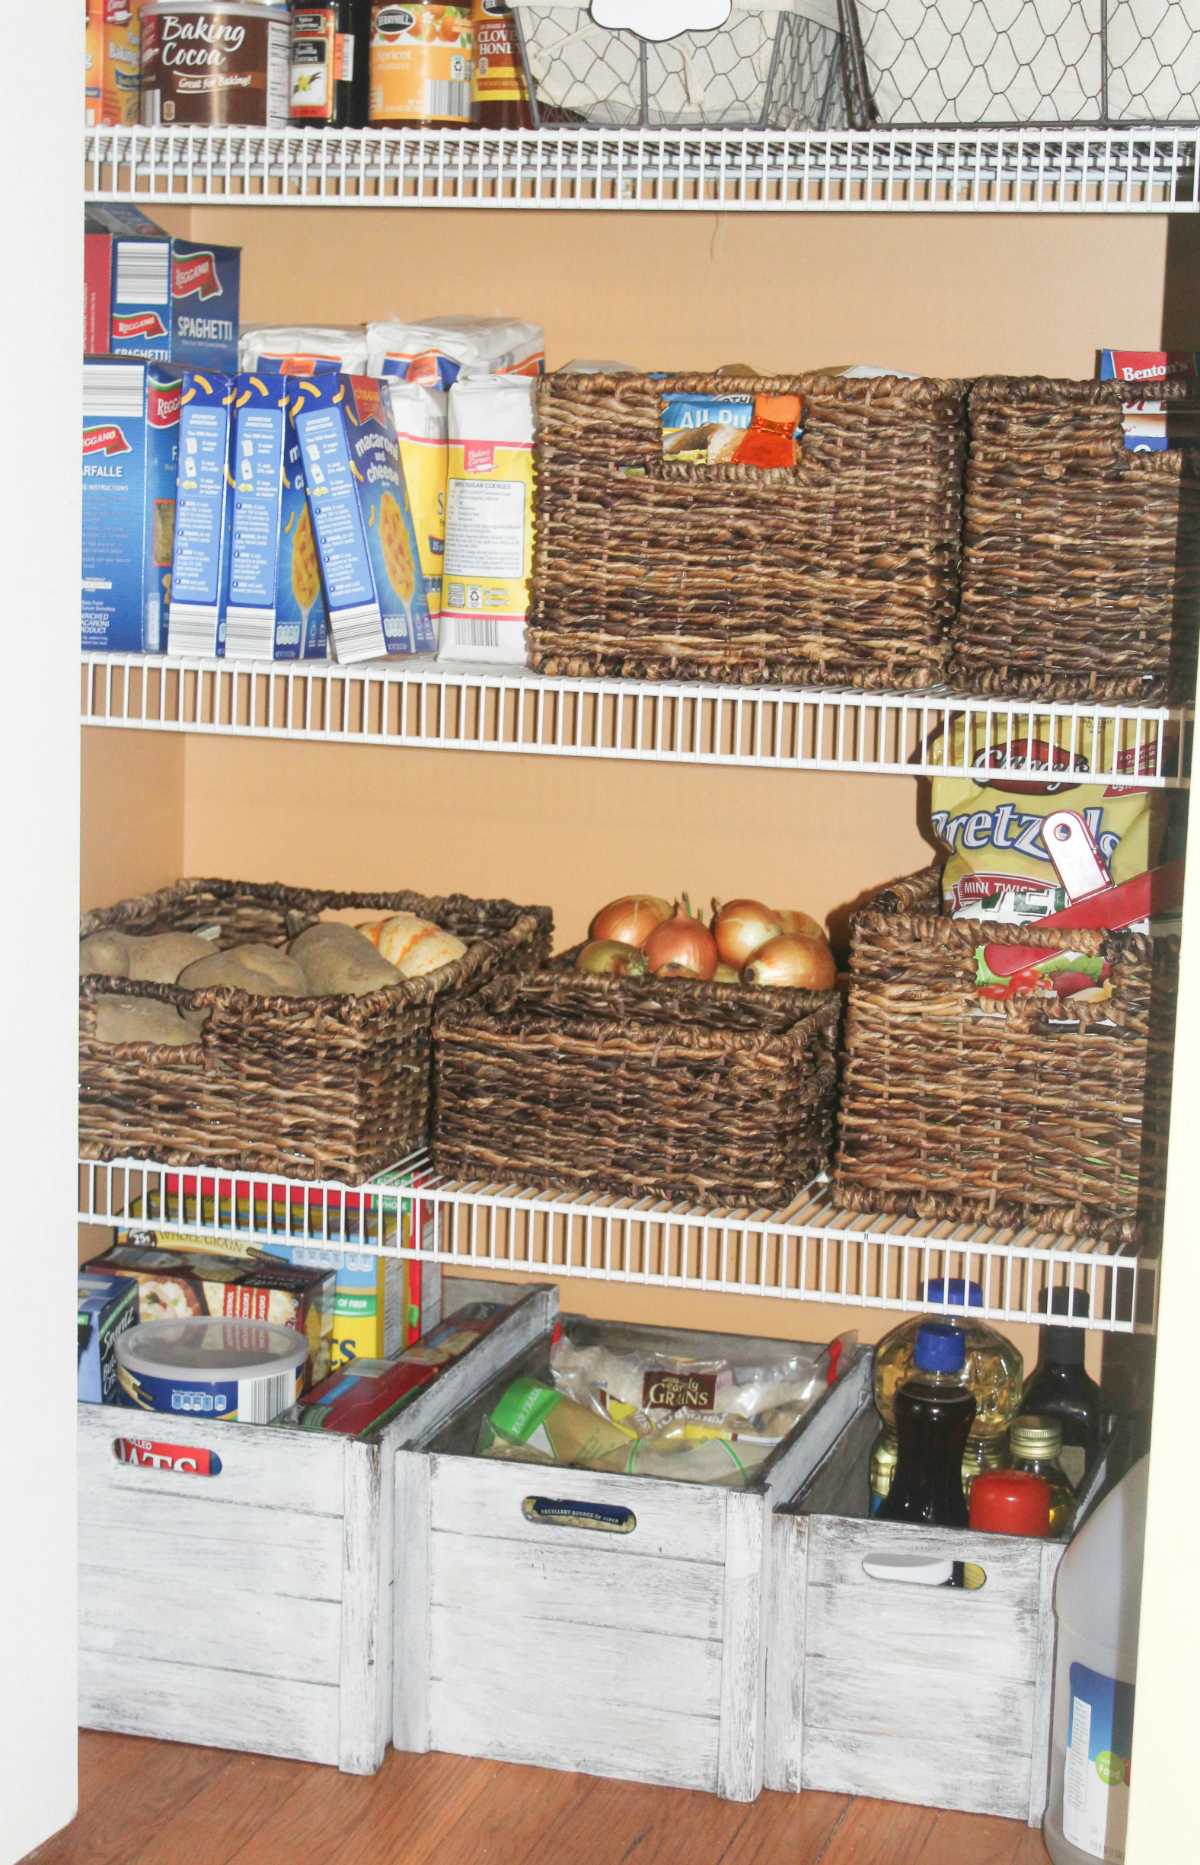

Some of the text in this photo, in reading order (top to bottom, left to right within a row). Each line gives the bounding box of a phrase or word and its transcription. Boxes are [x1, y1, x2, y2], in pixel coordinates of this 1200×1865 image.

[162, 16, 245, 52] Baking
[478, 30, 519, 43] CLOVE
[162, 42, 226, 66] Cocoa
[376, 49, 411, 62] Apricot
[479, 42, 519, 55] HONE
[179, 75, 251, 90] Great for Baking!
[175, 262, 209, 289] REGGANO
[118, 317, 155, 334] REGGANO
[178, 316, 233, 341] SPAGHETTI
[355, 433, 399, 461] macaroni
[82, 465, 123, 477] RFALLE
[367, 461, 399, 486] cheese
[89, 484, 128, 492] INSTRUCTIONS
[81, 612, 109, 620] NRICHED
[931, 804, 1121, 869] retzls
[964, 882, 989, 894] MINI
[376, 1201, 408, 1211] WHOE
[203, 1237, 243, 1252] GRAIN
[226, 1291, 234, 1318] ESTEROL
[241, 1292, 250, 1319] COLORS
[258, 1294, 267, 1322] LAVORS
[337, 1299, 368, 1309] OF FIBER
[649, 1383, 709, 1406] GRAINS
[511, 1418, 525, 1434] FAIR
[121, 1438, 197, 1472] ATS
[572, 1510, 594, 1519] SOURCE
[1098, 1763, 1121, 1780] Food
